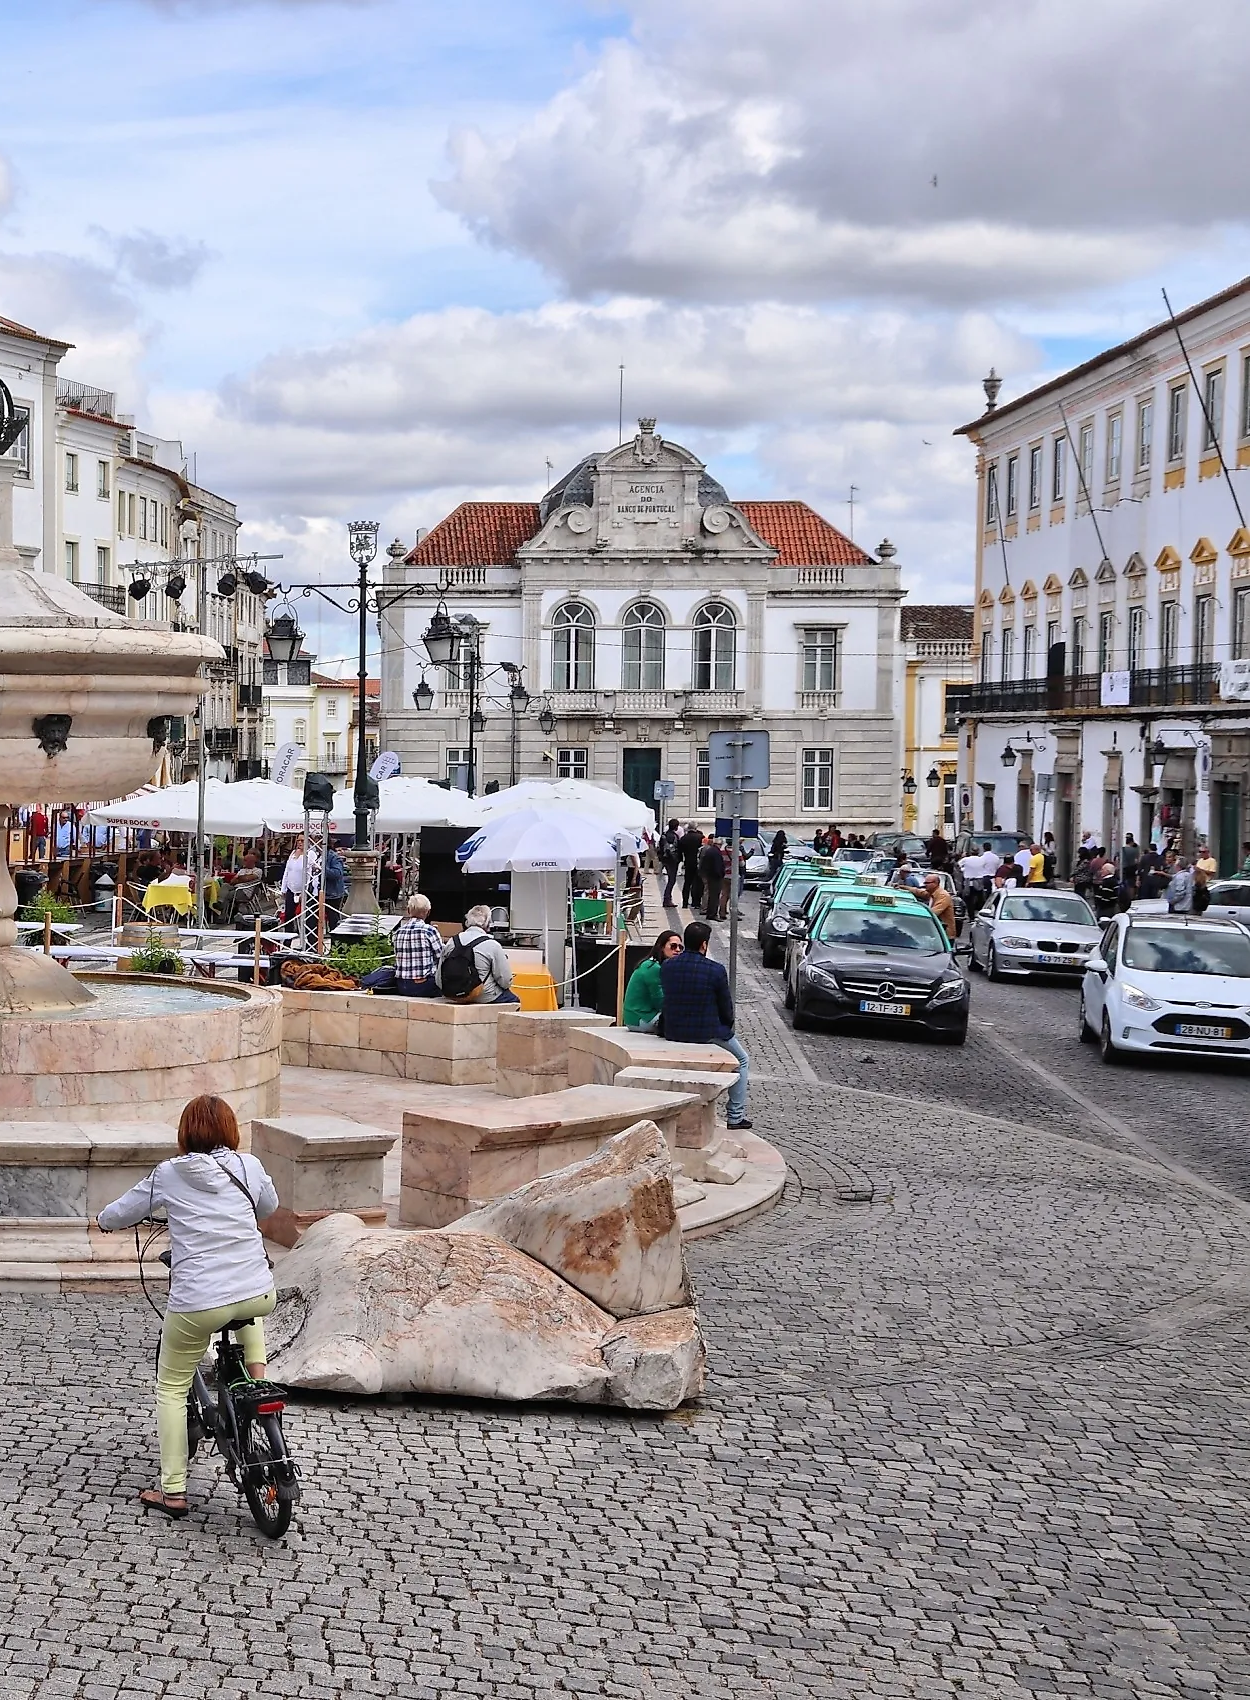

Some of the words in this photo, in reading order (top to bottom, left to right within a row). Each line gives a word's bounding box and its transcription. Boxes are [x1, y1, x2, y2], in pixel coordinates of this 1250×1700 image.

[281, 822, 304, 830] SUPER
[866, 1002, 904, 1014] 12-TF-33
[1181, 1025, 1225, 1037] 28-NU-81
